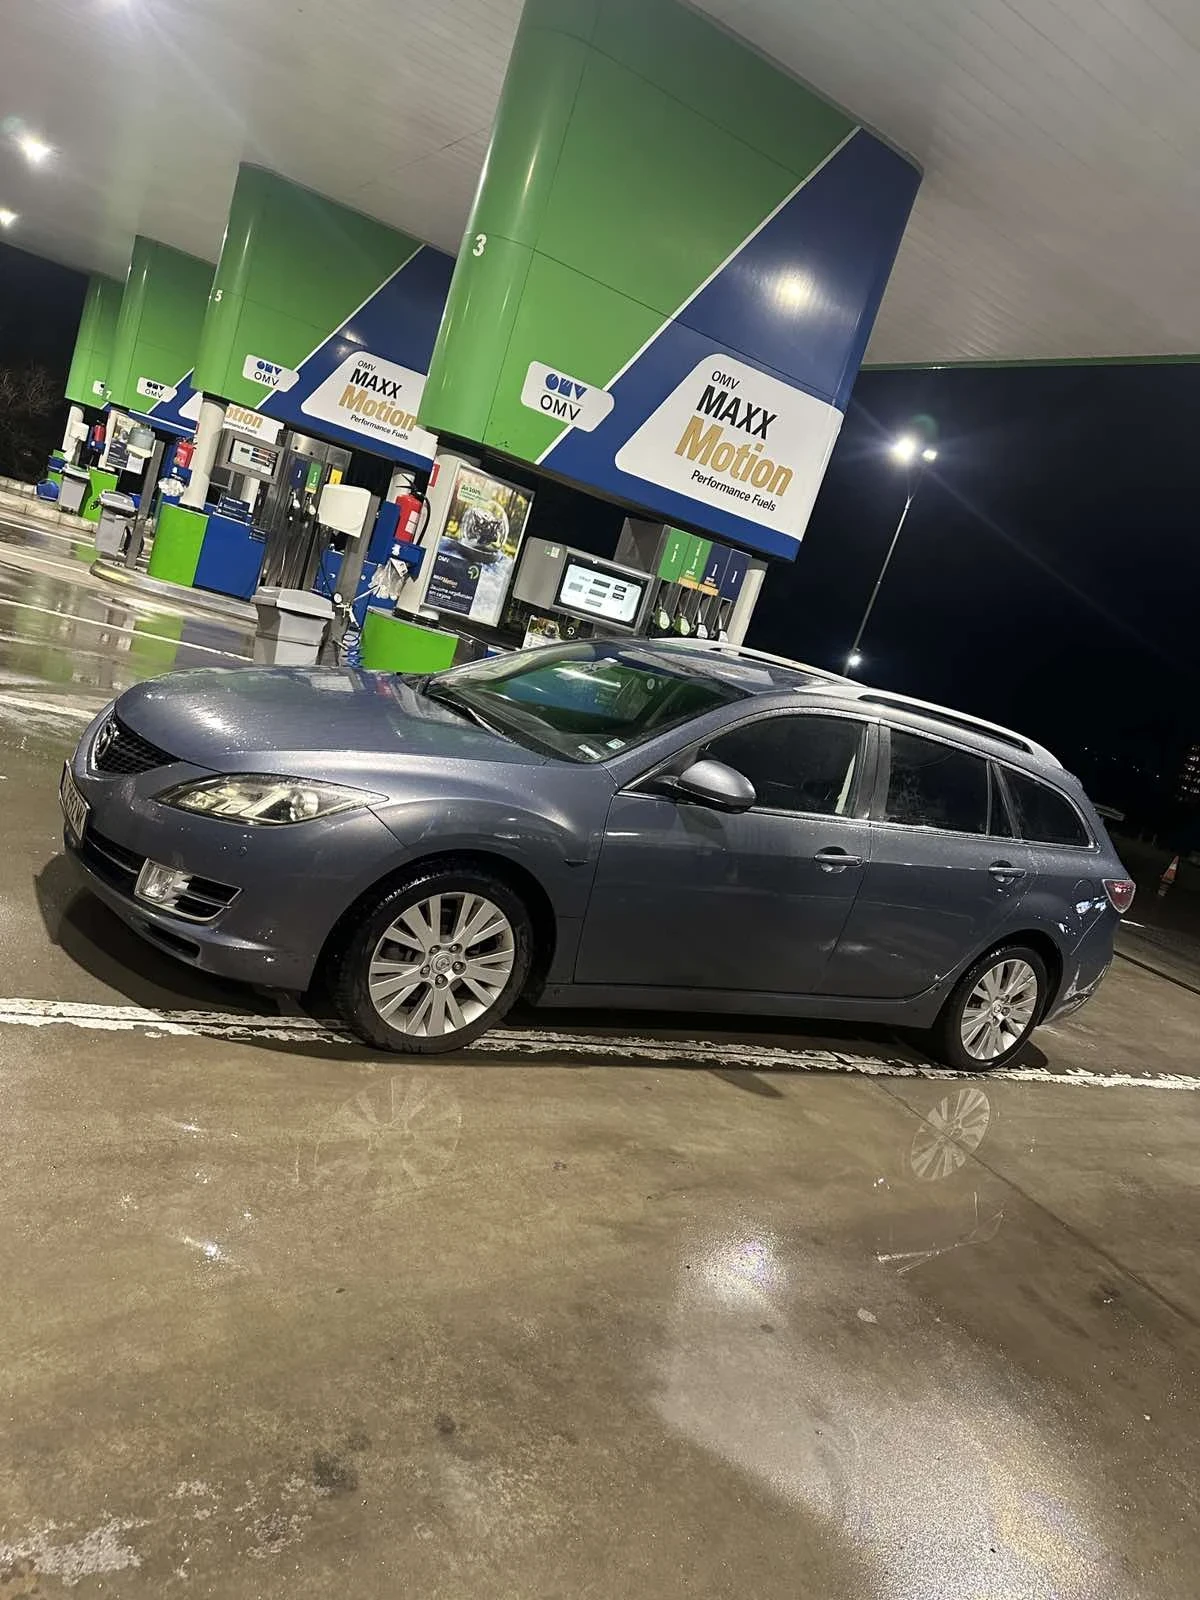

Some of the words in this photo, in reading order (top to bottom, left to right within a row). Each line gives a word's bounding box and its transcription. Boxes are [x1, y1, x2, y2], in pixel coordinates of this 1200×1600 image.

[472, 233, 487, 256] 3
[214, 290, 223, 302] 5
[357, 360, 377, 372] OMV
[254, 371, 280, 386] OMV
[349, 368, 402, 399] MAXX
[711, 370, 740, 390] OMV
[106, 390, 112, 399] 7
[145, 389, 163, 399] OMV
[338, 384, 417, 432] Motion
[540, 394, 582, 421] OMV
[696, 384, 778, 440] MAXX
[350, 414, 391, 434] Performance
[392, 426, 409, 440] Fuels
[674, 415, 794, 497] Motion
[691, 470, 750, 502] Performance
[751, 494, 777, 512] Fuels
